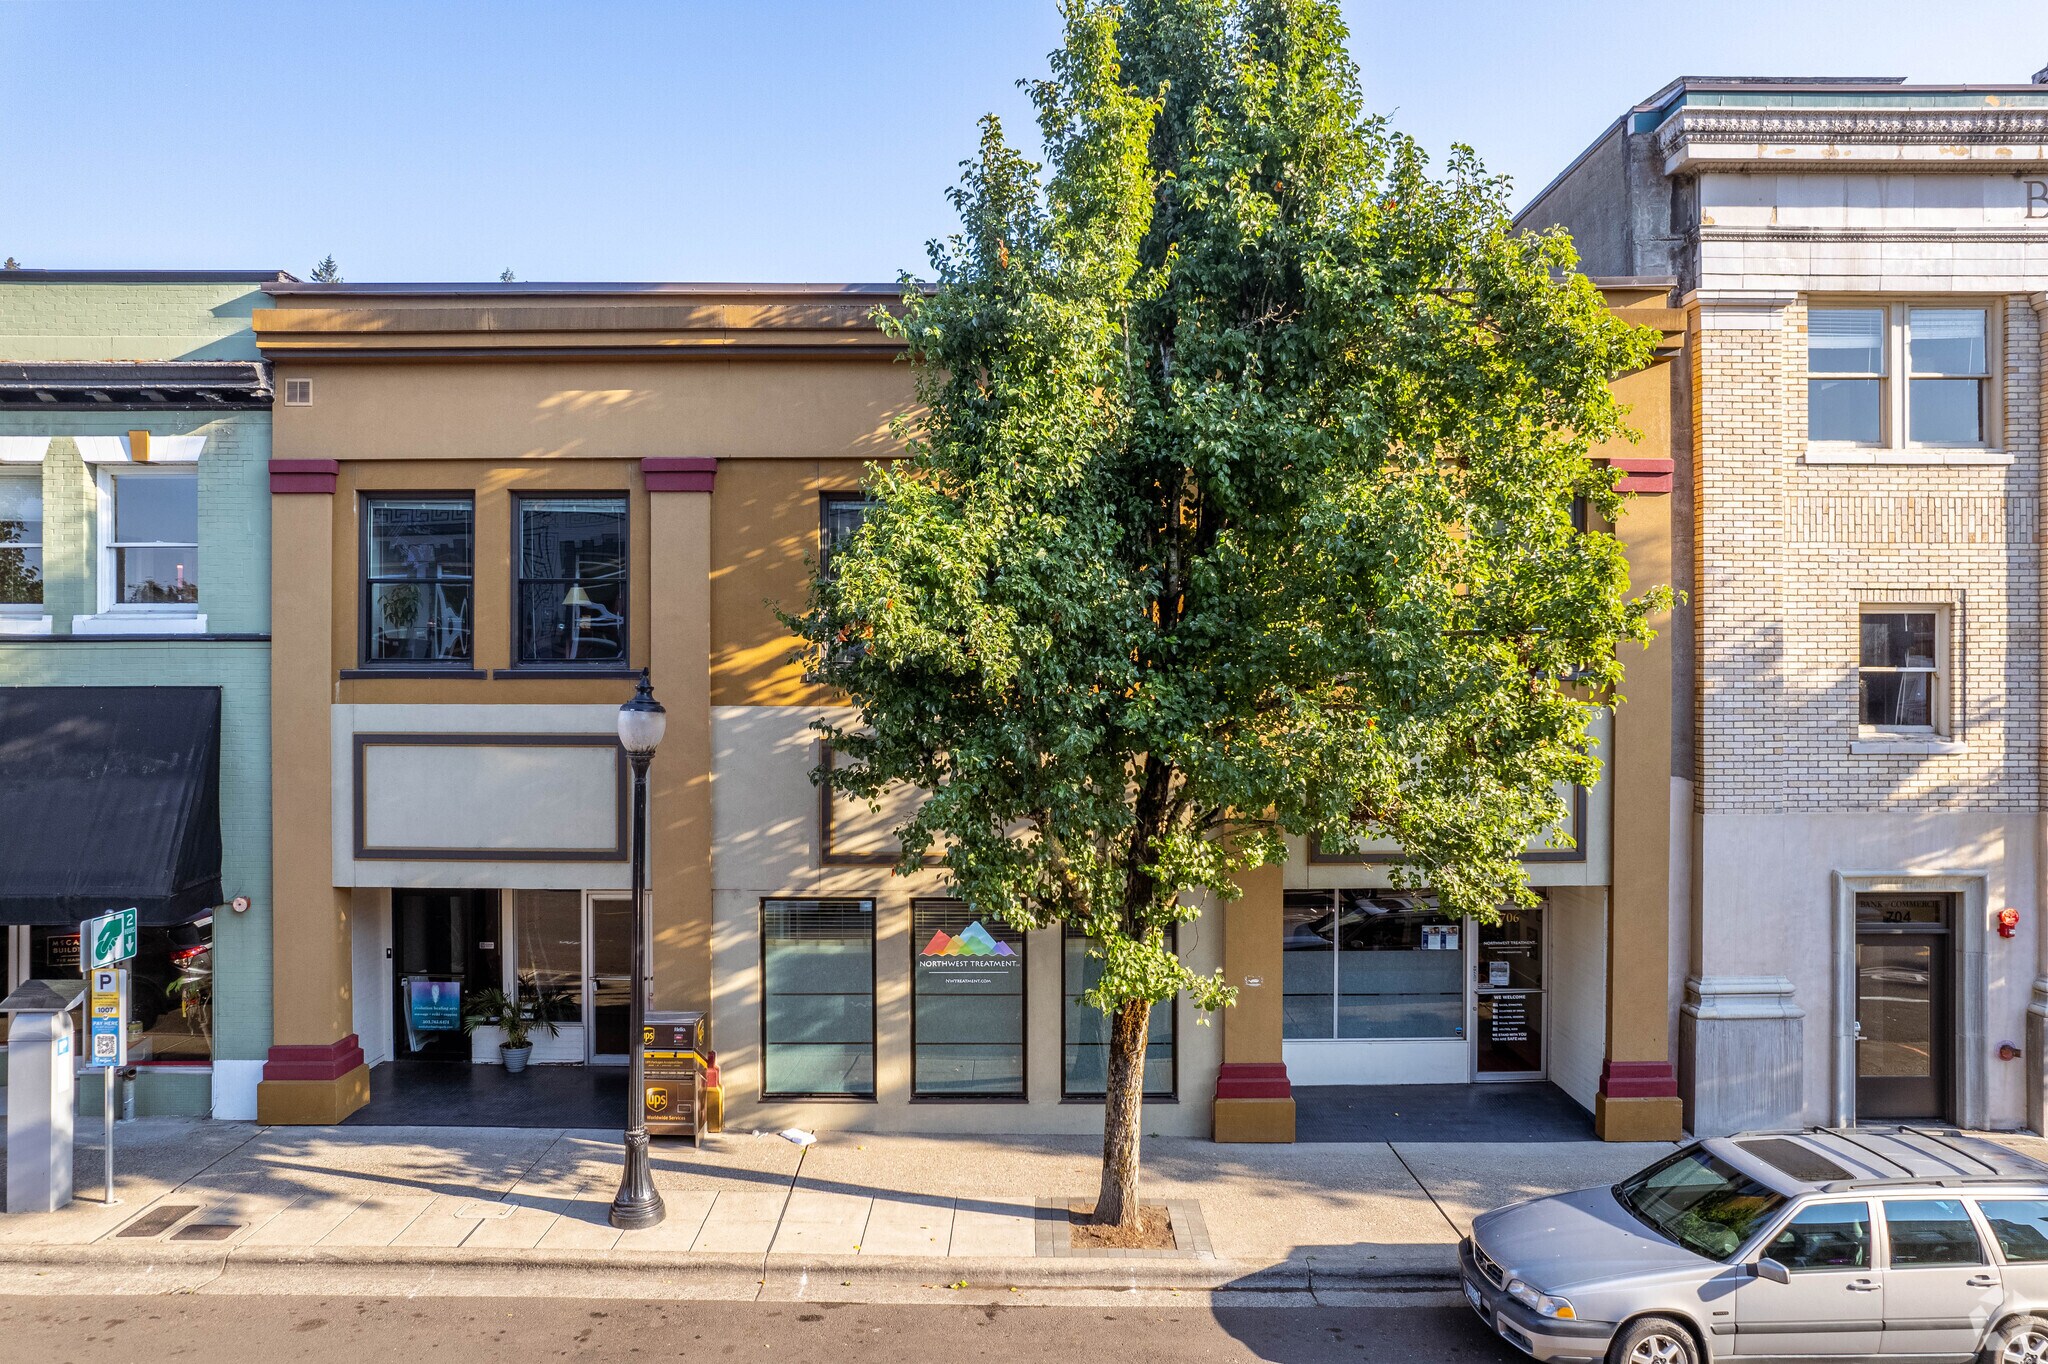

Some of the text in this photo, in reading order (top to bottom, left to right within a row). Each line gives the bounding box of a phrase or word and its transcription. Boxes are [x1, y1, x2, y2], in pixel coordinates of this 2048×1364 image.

[1860, 900, 1883, 908] BANK
[126, 914, 134, 926] 2
[1500, 912, 1520, 922] 706
[1885, 911, 1912, 923] 704
[919, 960, 968, 968] NORTHWEST
[100, 974, 112, 990] P
[648, 1095, 666, 1109] ups
